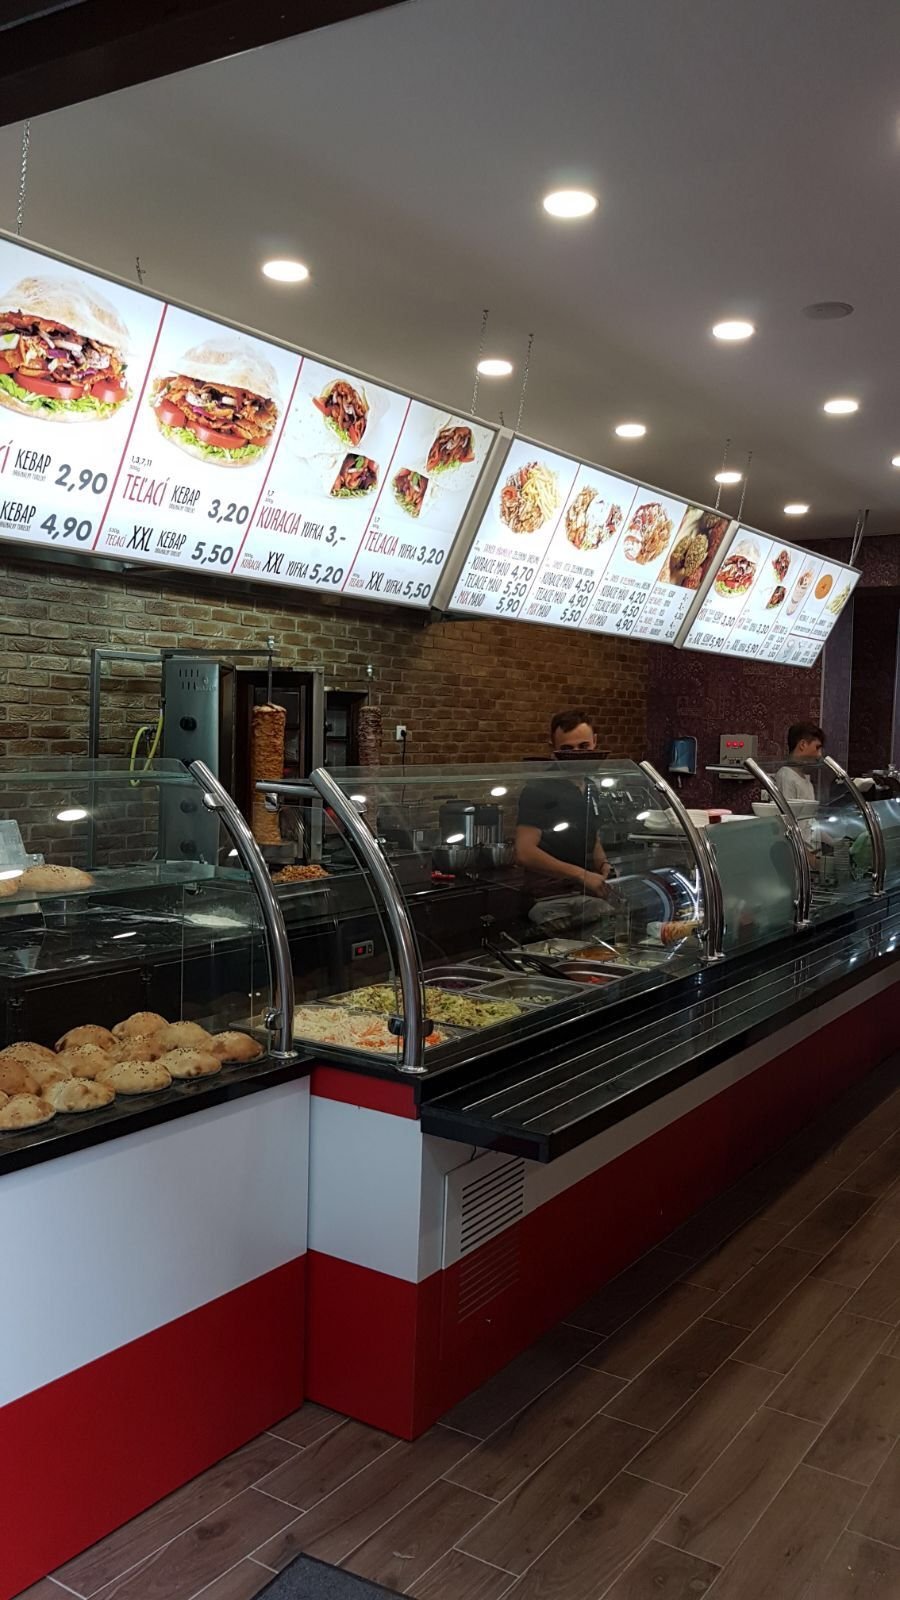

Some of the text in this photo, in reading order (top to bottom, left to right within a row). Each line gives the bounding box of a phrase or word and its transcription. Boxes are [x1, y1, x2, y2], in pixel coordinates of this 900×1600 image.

[14, 448, 52, 474] KEBAP
[54, 464, 108, 494] 2,90
[171, 484, 201, 507] KEBAP
[207, 499, 249, 525] 3,20
[0, 500, 92, 541] KEBAP 4,90
[256, 505, 346, 547] KURACIA YUFKA 3,-
[126, 525, 154, 552] XXL
[156, 530, 187, 550] KEBAP
[191, 541, 234, 565] 5,50
[397, 543, 417, 560] YUFKA
[417, 546, 445, 565] 3,20
[262, 551, 285, 574] XXL
[285, 561, 309, 579] YUFKA
[309, 563, 344, 584] 5,20
[511, 565, 534, 582] 4,70
[365, 570, 385, 592] XXL
[383, 579, 403, 594] YUFKA
[402, 581, 431, 599] 5,50
[503, 581, 527, 597] 5,50
[575, 578, 595, 594] 4,50
[495, 597, 520, 613] 5,90
[568, 594, 589, 608] 4,90
[628, 590, 646, 605] 4,20
[560, 608, 581, 623] 5,50
[622, 604, 640, 618] 4,50
[615, 618, 633, 631] 4,90
